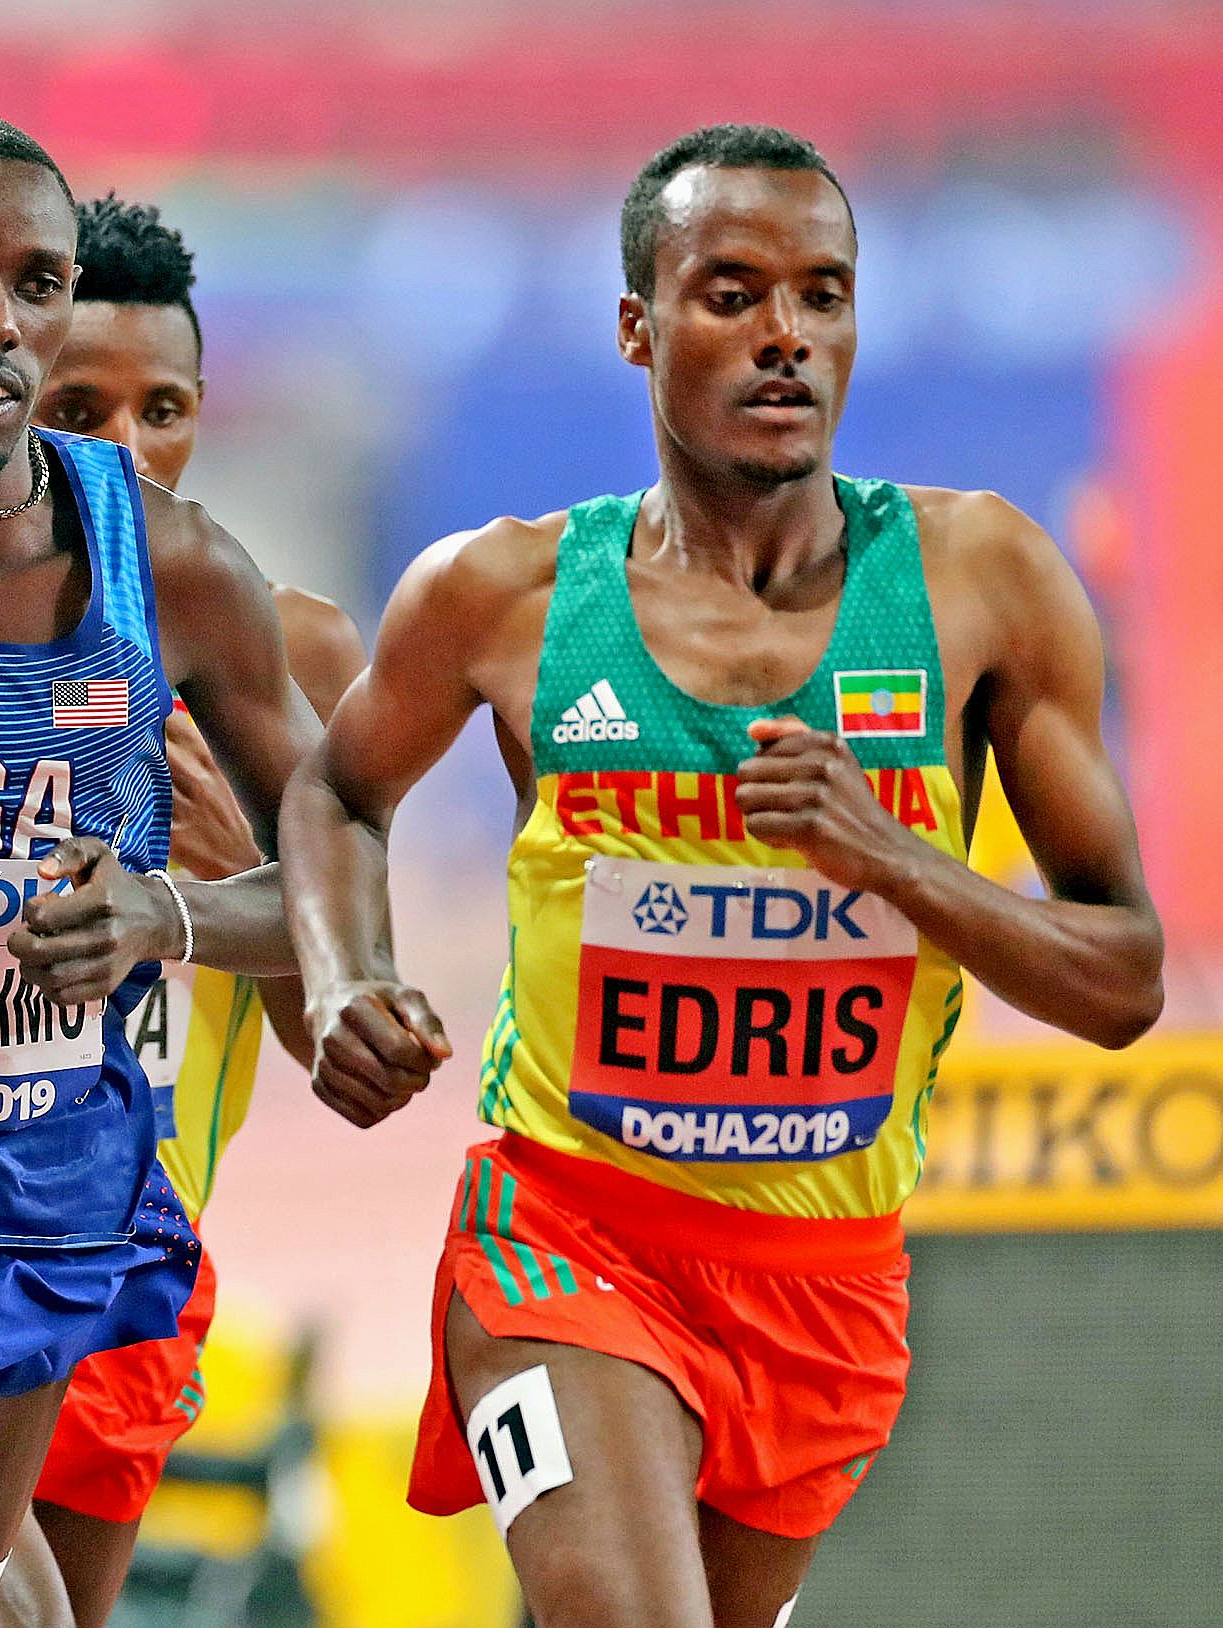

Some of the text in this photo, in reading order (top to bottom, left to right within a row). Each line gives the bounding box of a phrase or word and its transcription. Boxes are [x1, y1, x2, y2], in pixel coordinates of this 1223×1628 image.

[552, 717, 640, 744] adidas
[557, 768, 938, 842] ETHIIA
[690, 884, 869, 941] TDK
[599, 976, 884, 1078] EDRIS
[621, 1104, 851, 1156] DOHA2019
[478, 1401, 535, 1503] 11
